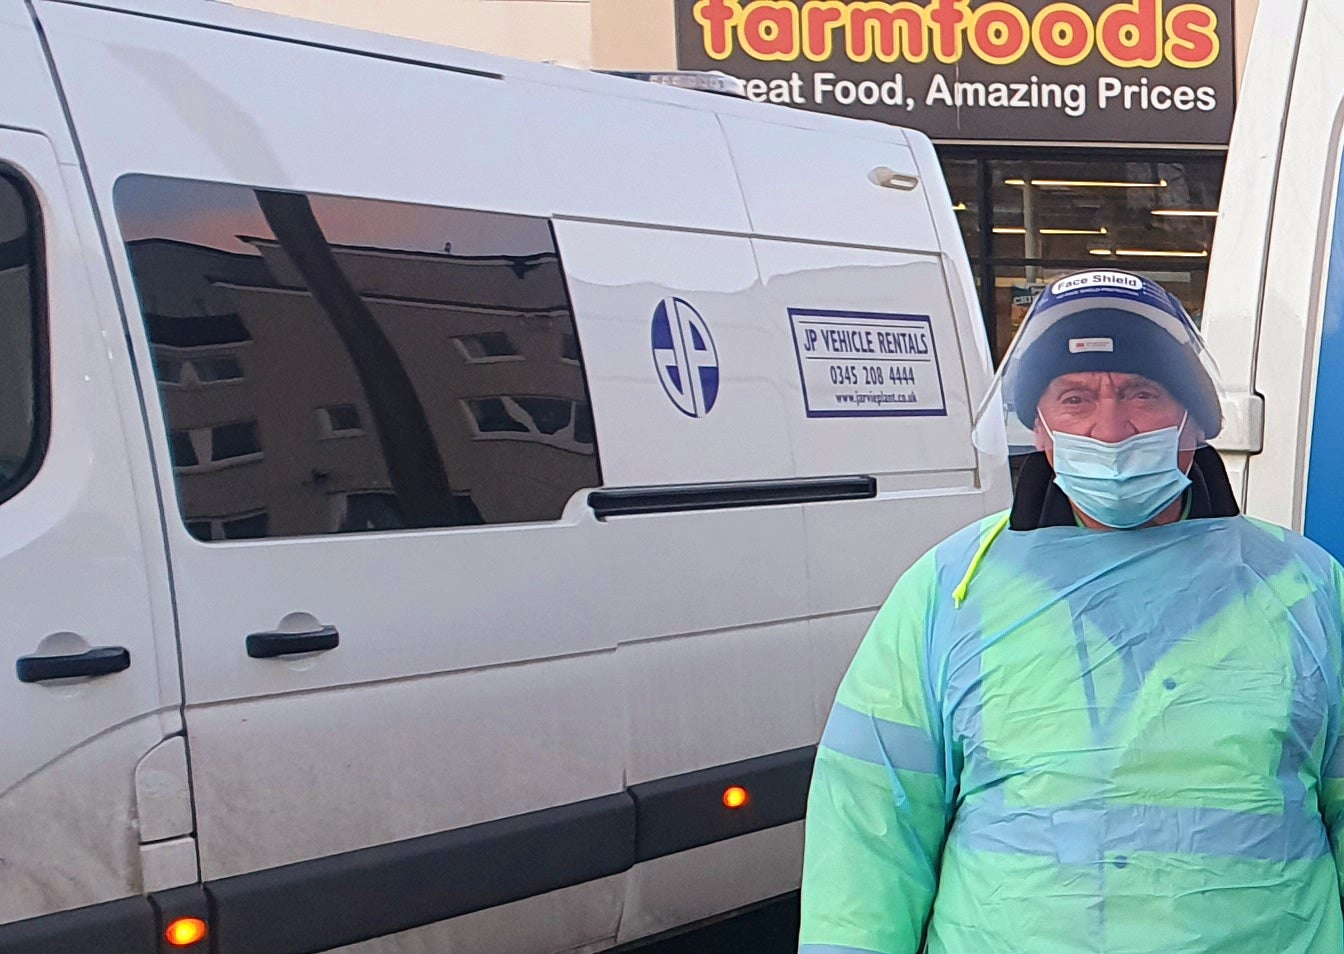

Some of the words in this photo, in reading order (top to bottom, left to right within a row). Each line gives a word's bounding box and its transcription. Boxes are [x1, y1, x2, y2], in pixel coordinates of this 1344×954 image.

[693, 0, 1219, 68] farmfoods
[740, 72, 805, 103] eat
[813, 73, 914, 111] Food,
[925, 74, 1085, 116] Amazing
[1098, 77, 1216, 111] Prices
[1057, 278, 1088, 291] Face
[1092, 275, 1137, 287] Shield
[804, 329, 817, 351] JP
[820, 329, 874, 353] VEHICLE
[877, 332, 928, 354] RENTALS
[830, 365, 858, 385] 0345
[863, 366, 884, 385] 208
[889, 366, 915, 385] 4444
[835, 391, 917, 406] www.jarvieplant.co.uk
